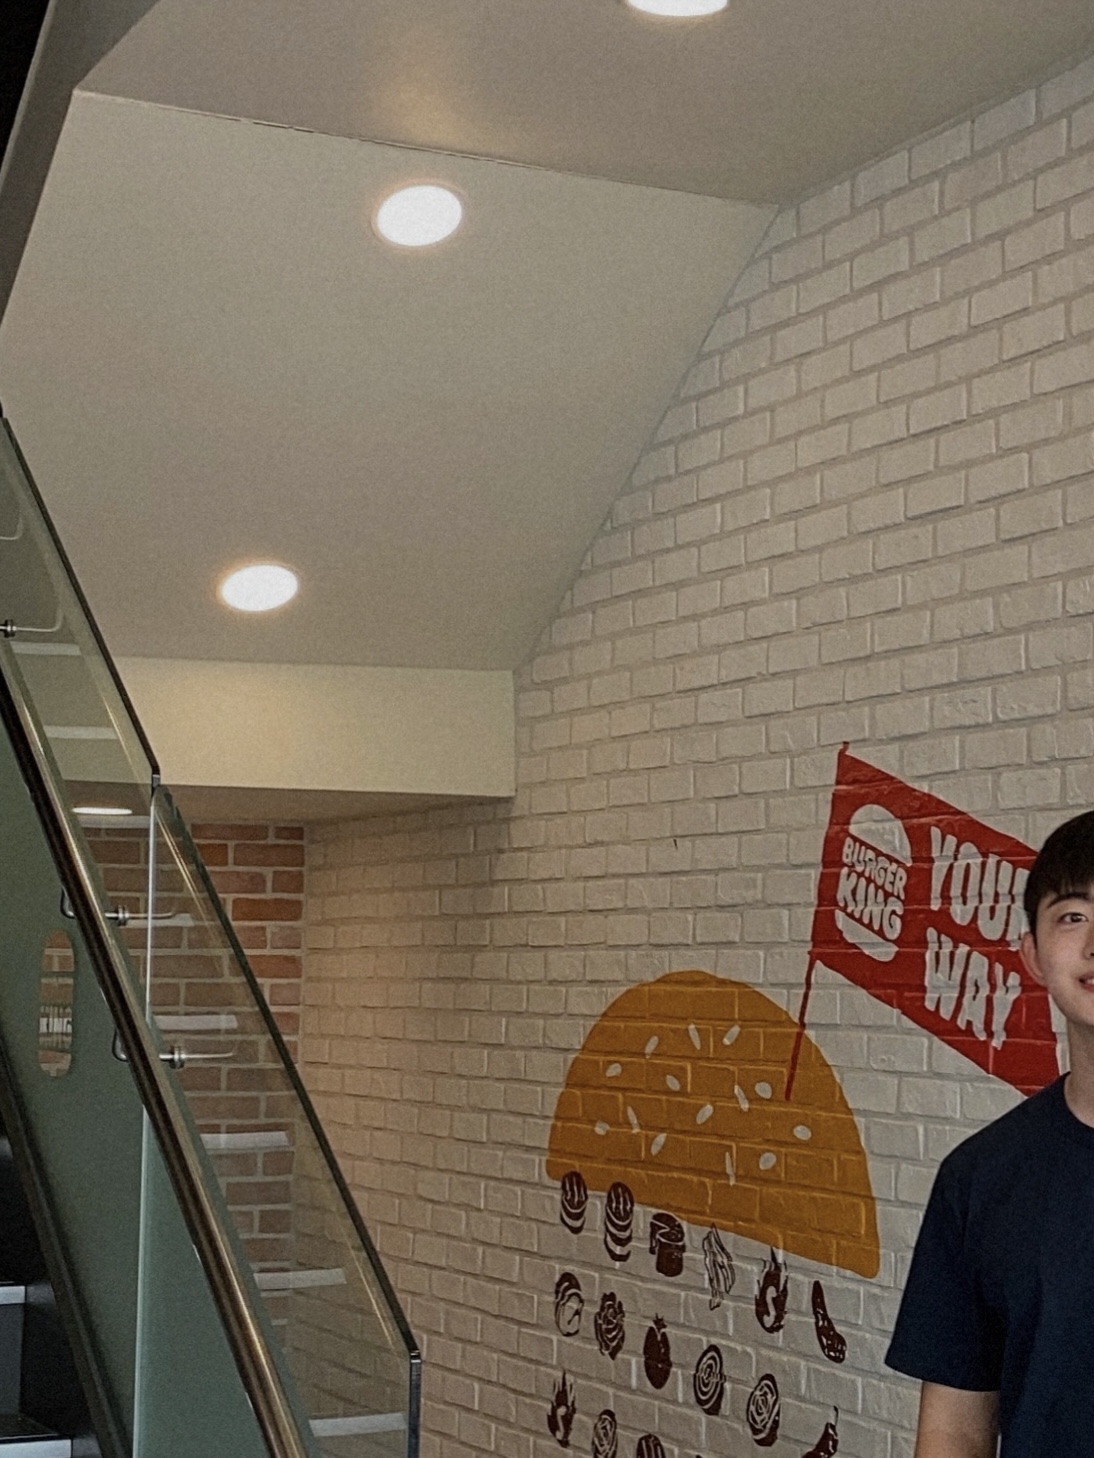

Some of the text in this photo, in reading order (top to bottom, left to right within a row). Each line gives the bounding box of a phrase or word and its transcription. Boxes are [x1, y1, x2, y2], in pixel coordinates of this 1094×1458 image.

[836, 866, 904, 940] KING
[842, 837, 907, 900] BURGER
[925, 926, 1021, 1050] WAY
